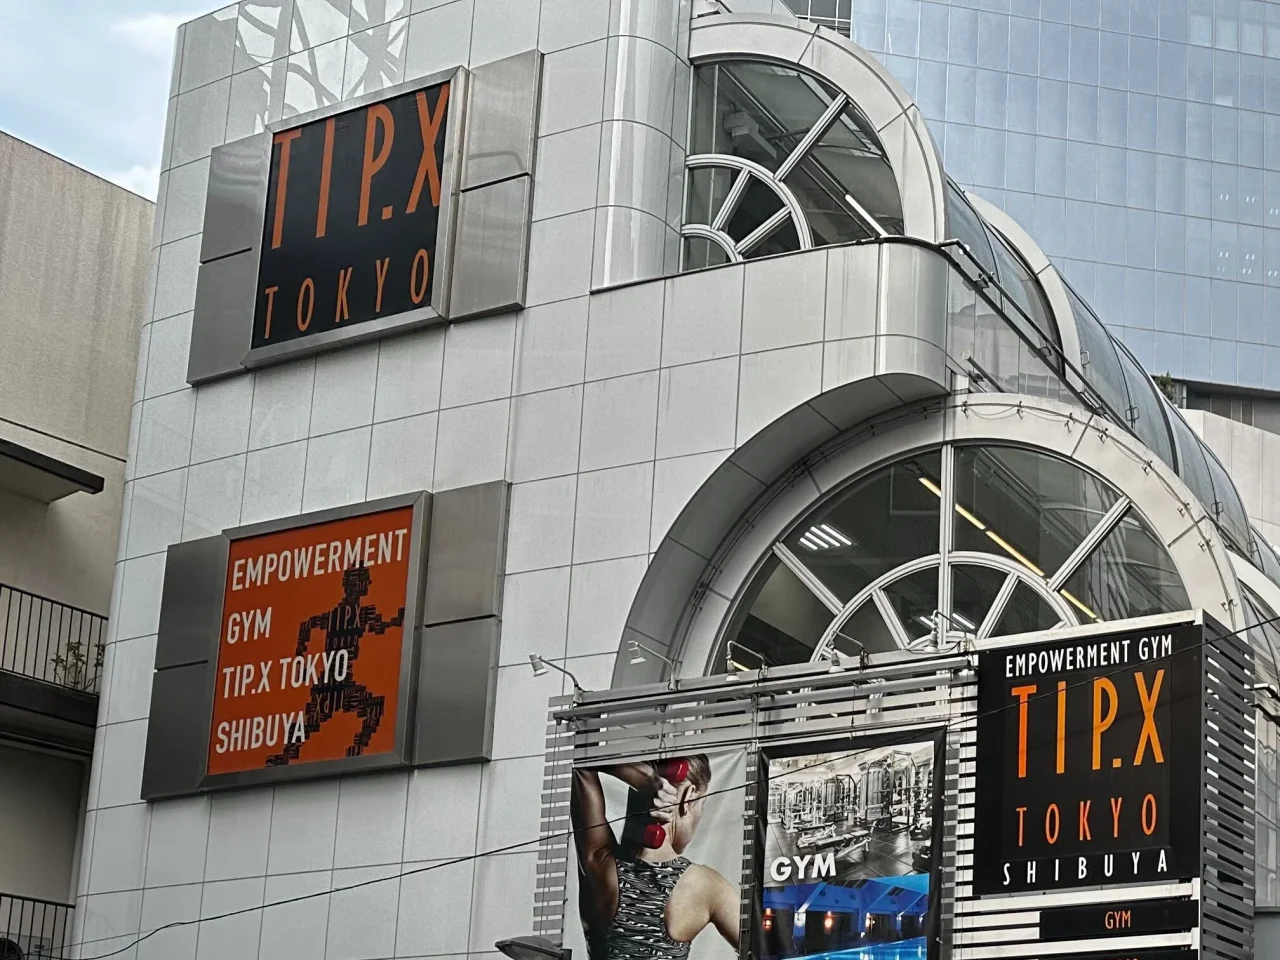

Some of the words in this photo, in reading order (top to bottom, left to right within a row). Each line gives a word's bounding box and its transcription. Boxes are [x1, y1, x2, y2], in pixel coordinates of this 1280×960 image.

[271, 83, 450, 249] TIP.X
[263, 248, 429, 339] TOKYO
[231, 528, 408, 591] EMPOWERMENT
[227, 607, 272, 644] GYM
[223, 660, 272, 699] TIP.X
[279, 648, 349, 691] TOKYO
[1005, 639, 1131, 678] EMPOWERMENT
[1138, 634, 1173, 661] GYM
[215, 711, 306, 754] SHIBUYA
[1011, 669, 1165, 778] TIP.X
[1016, 793, 1157, 847] TOKYO
[769, 852, 837, 883] GYM
[1003, 849, 1168, 886] SHIBUYA
[1104, 911, 1132, 930] GYM
